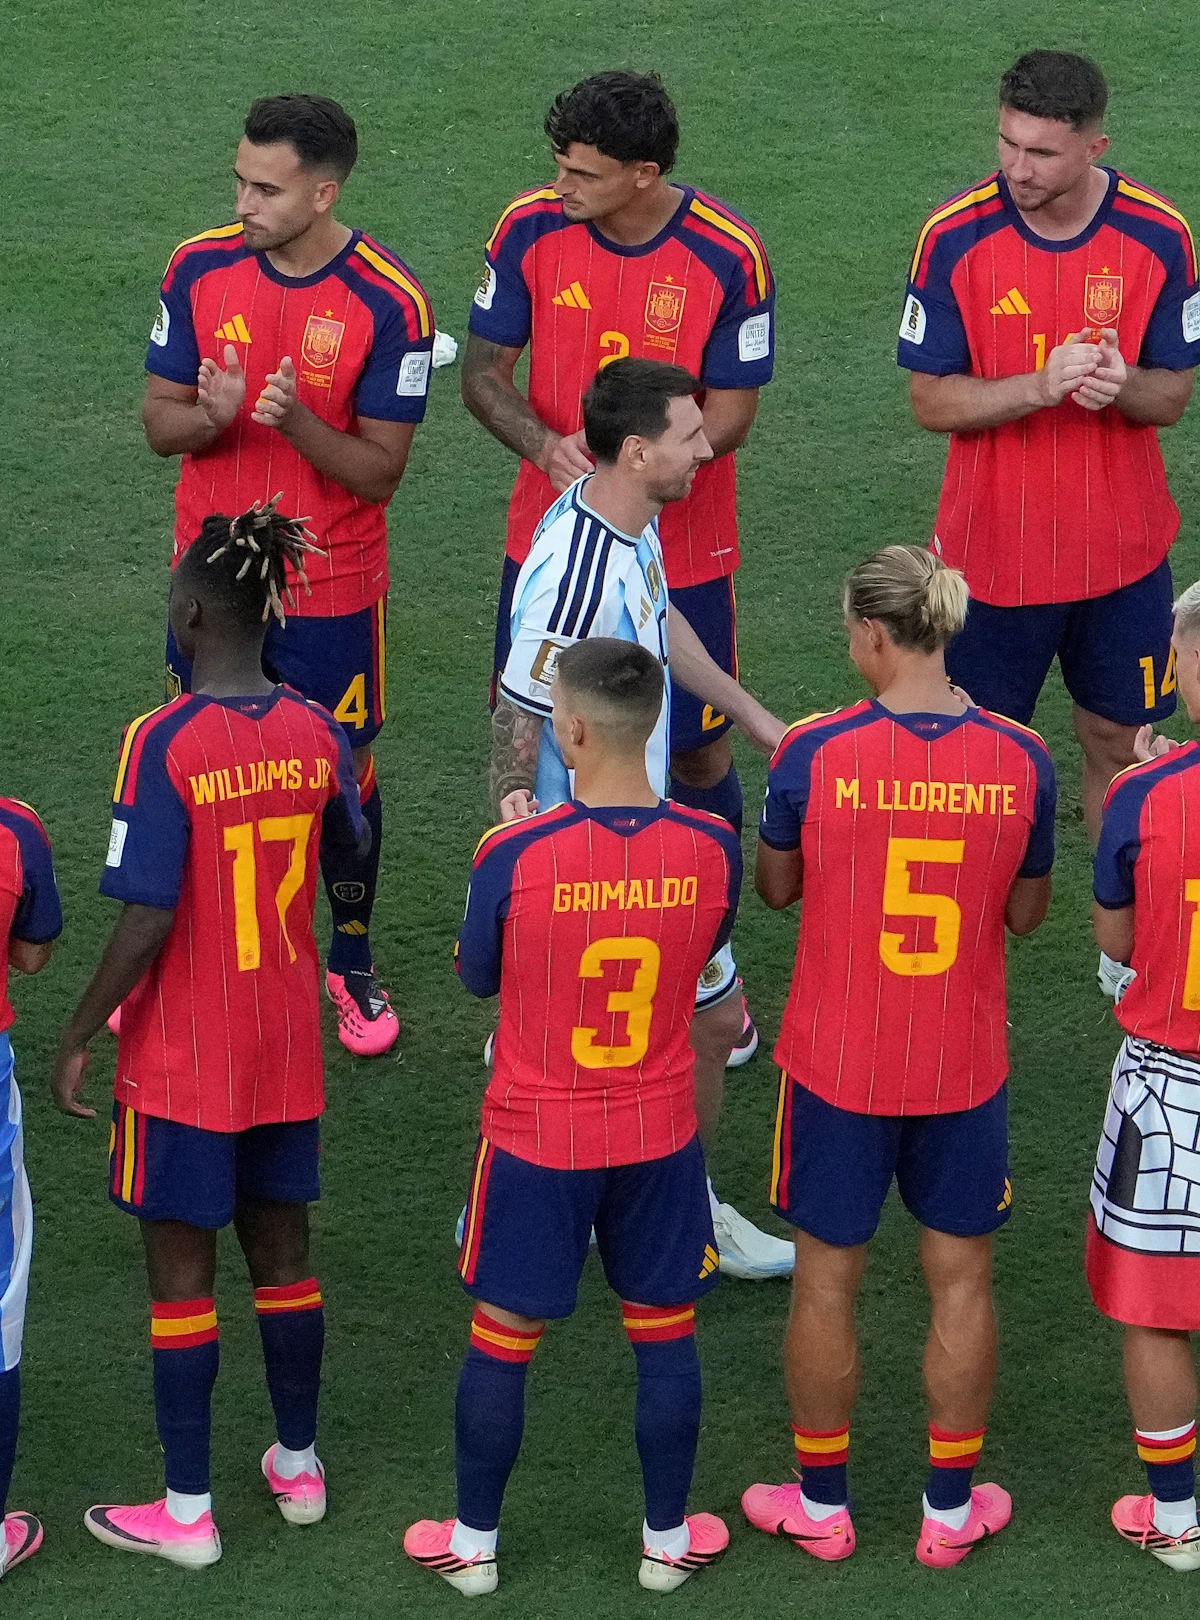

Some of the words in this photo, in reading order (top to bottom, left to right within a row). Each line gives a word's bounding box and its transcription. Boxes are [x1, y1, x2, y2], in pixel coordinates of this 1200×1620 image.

[600, 330, 630, 369] 2
[333, 672, 369, 730] 4
[188, 758, 303, 806] WILLIAMS
[835, 777, 867, 810] M.
[876, 779, 1017, 816] LLORENTE
[222, 812, 316, 972] 17
[553, 875, 698, 914] GRIMALDO
[878, 837, 966, 977] 5
[570, 936, 662, 1070] 3
